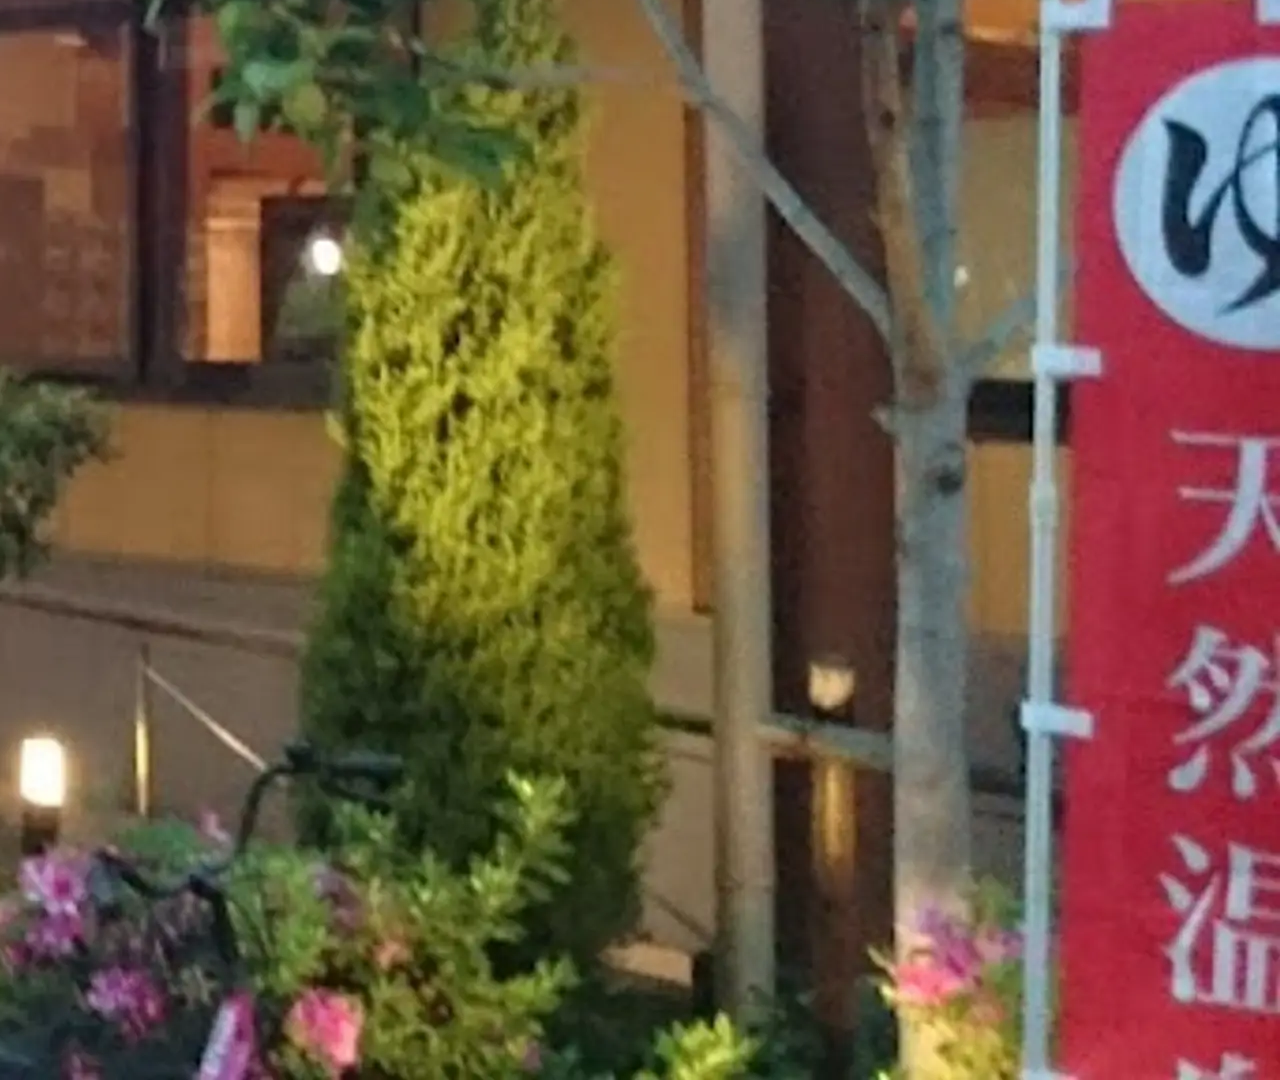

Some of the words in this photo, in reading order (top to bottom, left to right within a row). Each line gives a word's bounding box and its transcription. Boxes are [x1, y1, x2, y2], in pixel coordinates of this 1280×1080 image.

[1160, 92, 1280, 318] ゆ
[1159, 428, 1280, 1080] 天然温
